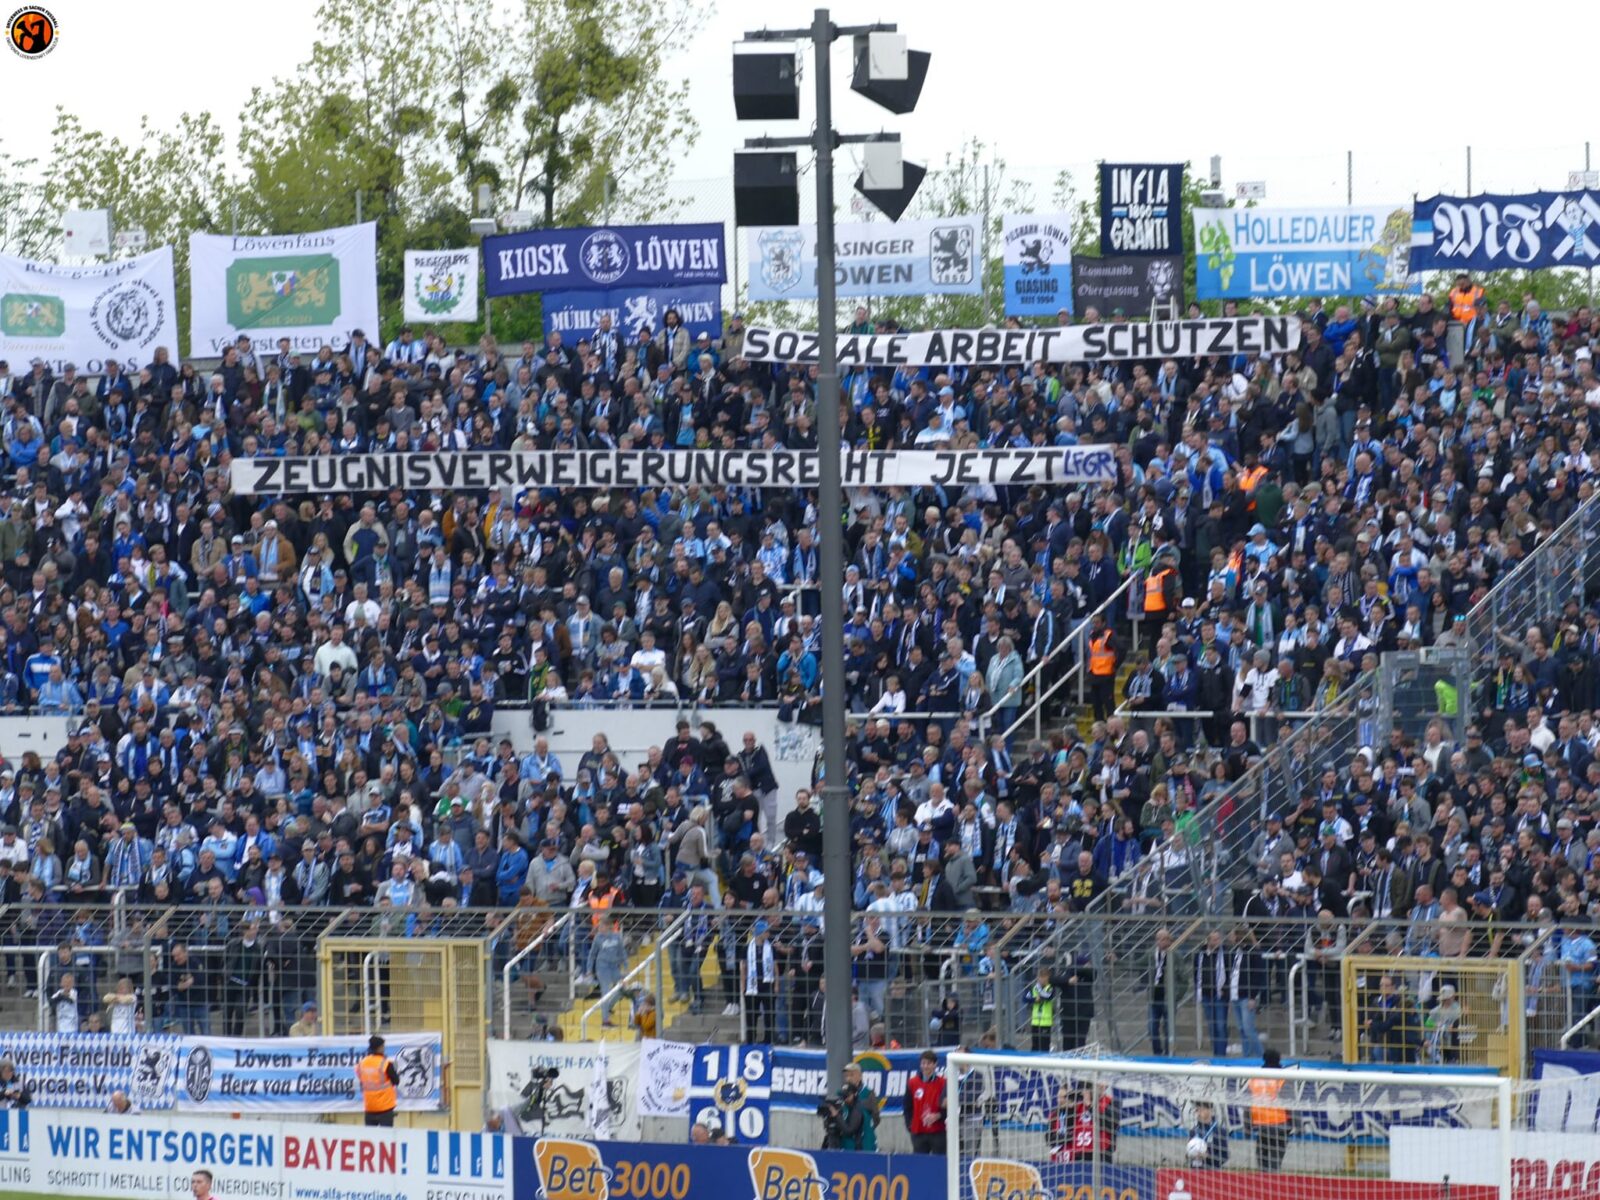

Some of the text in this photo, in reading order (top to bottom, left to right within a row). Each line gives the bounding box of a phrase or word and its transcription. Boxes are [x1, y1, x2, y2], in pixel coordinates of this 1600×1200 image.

[1112, 168, 1169, 204] INFLA
[231, 233, 336, 252] Löwenfans
[1110, 217, 1170, 250] GRANTI
[1234, 212, 1376, 245] HOLLEDAUER
[498, 235, 719, 281] KIOSK LÖWEN
[813, 239, 915, 257] ASINGER
[813, 262, 914, 287] ÖWEN
[1250, 254, 1351, 292] LÖWEN
[210, 334, 324, 352] Varsttten
[745, 318, 1288, 364] SOZALE ARBEIT SCHÜTZEN
[253, 451, 1064, 491] ZEUGNISVERWEIGERUNGSREHT JETZT
[234, 1047, 292, 1069] Löwen
[528, 1055, 610, 1070] LÖWEN-FAS
[75, 1074, 107, 1095] e.V.
[221, 1073, 257, 1096] Herz
[263, 1078, 291, 1095] von
[296, 1073, 356, 1099] Giesing
[771, 1066, 828, 1096] SECHZ
[47, 1124, 408, 1175] WIR ENTSORGEN BAYERN!
[1077, 1130, 1092, 1147] 55
[47, 1169, 100, 1187] SCHROTT
[110, 1174, 162, 1191] METALLE
[173, 1176, 285, 1198] COINERDIENST
[547, 1155, 691, 1199] Bet 3000
[764, 1165, 909, 1200] Bet 3000
